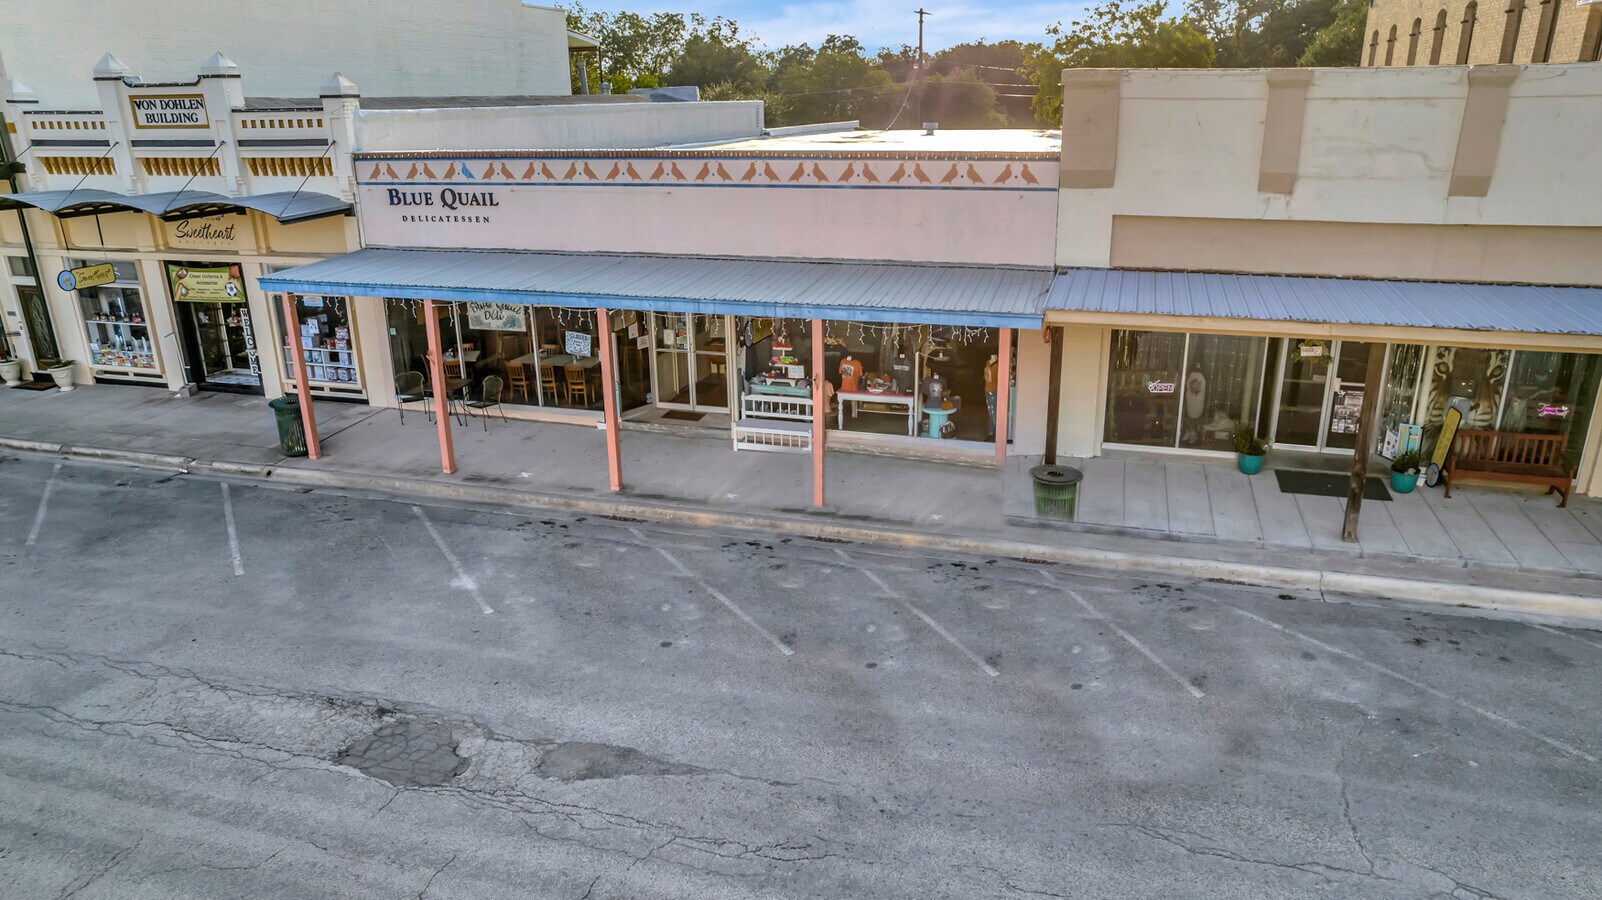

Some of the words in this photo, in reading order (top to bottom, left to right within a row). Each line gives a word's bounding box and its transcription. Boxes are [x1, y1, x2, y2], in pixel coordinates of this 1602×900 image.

[133, 100, 158, 110] VON
[160, 99, 204, 110] DOHLEN
[145, 112, 199, 123] BUILDING
[387, 188, 434, 206] BLUE
[440, 188, 499, 210] QUAIL
[402, 215, 490, 223] DELICATESSEN
[175, 219, 236, 241] Sweetheart
